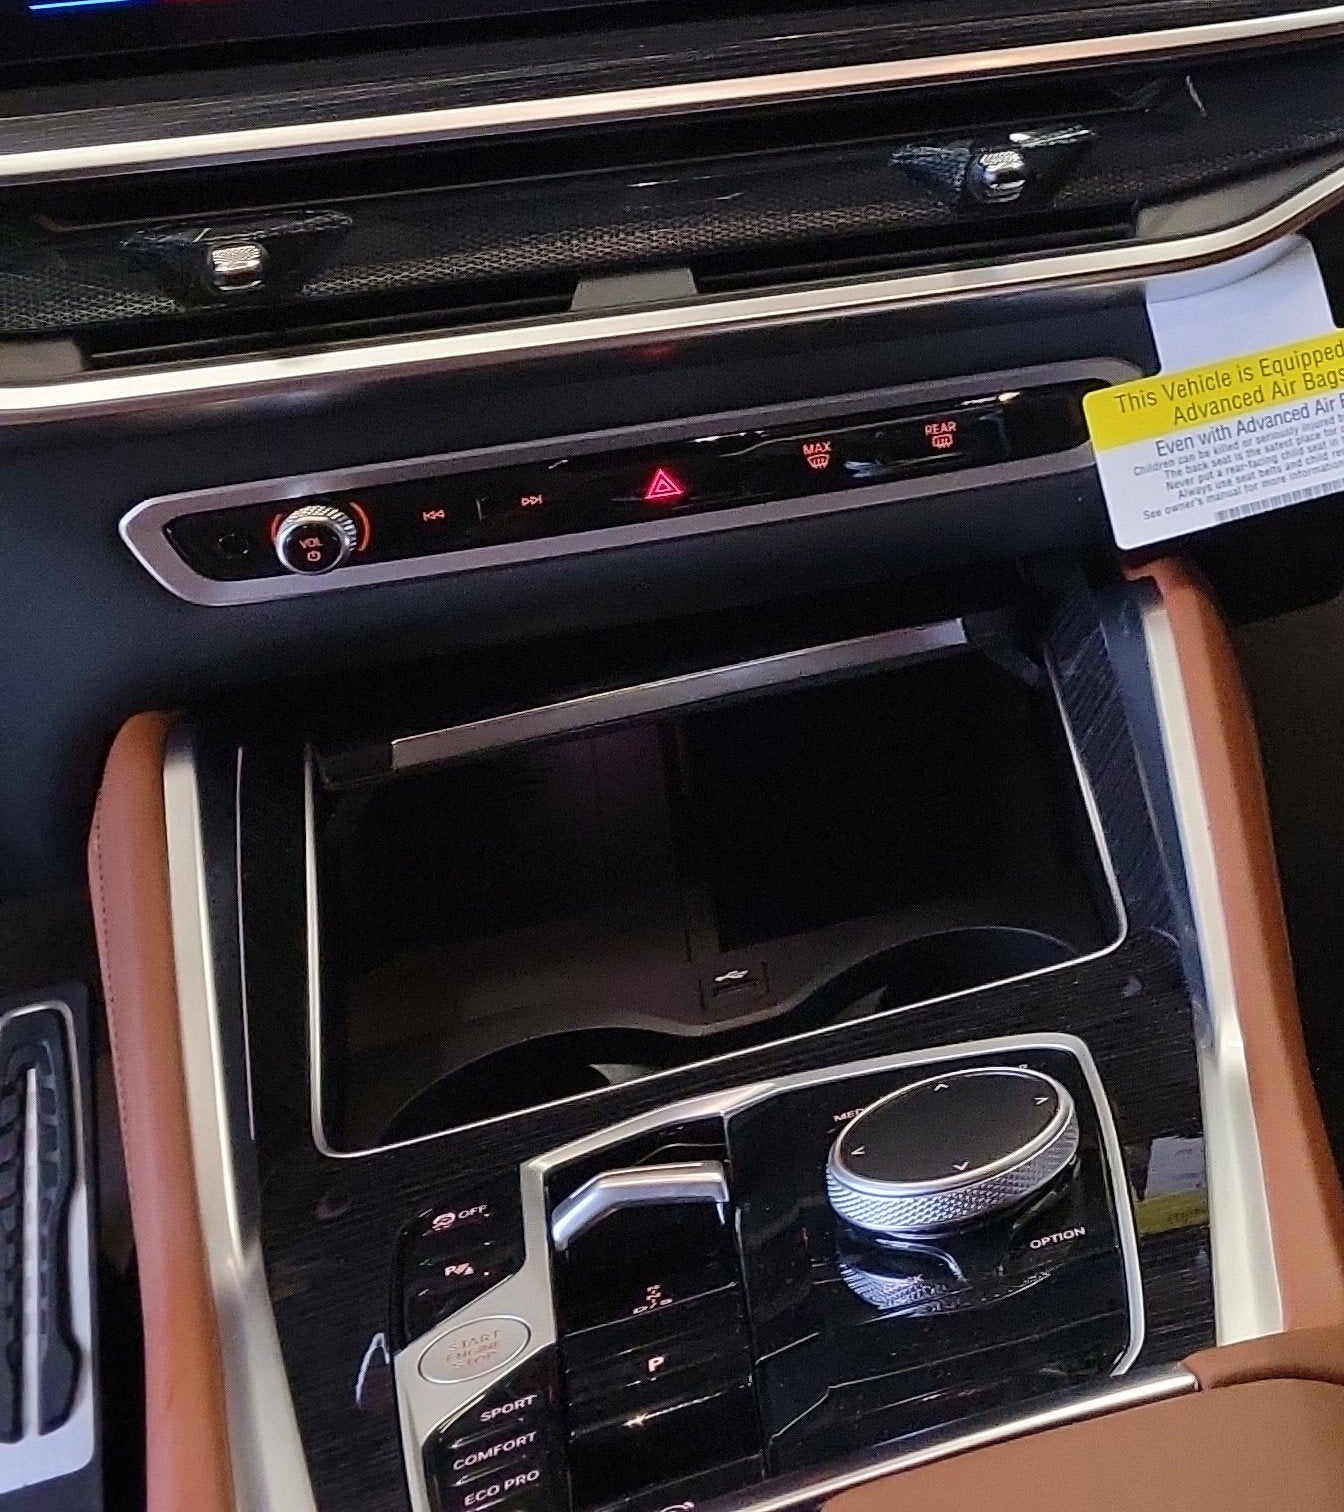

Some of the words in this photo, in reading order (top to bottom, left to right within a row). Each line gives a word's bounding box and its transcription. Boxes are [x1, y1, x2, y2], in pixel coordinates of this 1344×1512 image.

[1114, 390, 1157, 412] This
[1161, 371, 1231, 400] Vehicle
[1236, 364, 1253, 382] is
[1259, 340, 1344, 376] Equipped
[1174, 385, 1264, 424] Advanced
[1272, 378, 1296, 399] Air
[924, 422, 957, 435] REAR
[1155, 436, 1194, 456] Even
[1197, 424, 1231, 444] with
[1236, 403, 1309, 435] Advanced
[1315, 397, 1334, 415] Air
[803, 441, 832, 455] MAX
[1133, 459, 1174, 475] Children
[1177, 453, 1195, 464] can
[1197, 449, 1210, 458] be
[1213, 440, 1239, 454] killed
[1163, 469, 1180, 478] The
[1184, 461, 1208, 473] back
[1211, 454, 1231, 466] seat
[1233, 452, 1243, 460] is
[1245, 448, 1261, 457] the
[1264, 438, 1292, 452] safest
[1296, 432, 1320, 446] place
[1322, 427, 1336, 436] for
[1165, 477, 1193, 489] Never
[1197, 470, 1214, 483] put
[1225, 454, 1278, 474] rear-facing
[1280, 446, 1304, 460] child
[1306, 440, 1326, 453] seat
[1329, 438, 1339, 447] in
[1142, 509, 1162, 519] See
[1164, 497, 1202, 513] owner's
[1206, 486, 1241, 502] manual
[1243, 482, 1257, 493] for
[1261, 475, 1286, 487] more
[1289, 460, 1344, 480] information
[1178, 483, 1212, 499] Always
[1215, 478, 1232, 489] use
[1235, 471, 1255, 483] seat
[1257, 465, 1281, 477] belts
[1285, 458, 1302, 470] and
[1305, 452, 1328, 465] child
[458, 1205, 487, 1219] OFF
[1029, 1226, 1086, 1250] OPTION
[648, 1356, 665, 1372] P
[480, 1394, 537, 1422] SPORT
[452, 1431, 537, 1471] COMFORT
[464, 1485, 500, 1506] ECO
[504, 1469, 540, 1493] PRO
